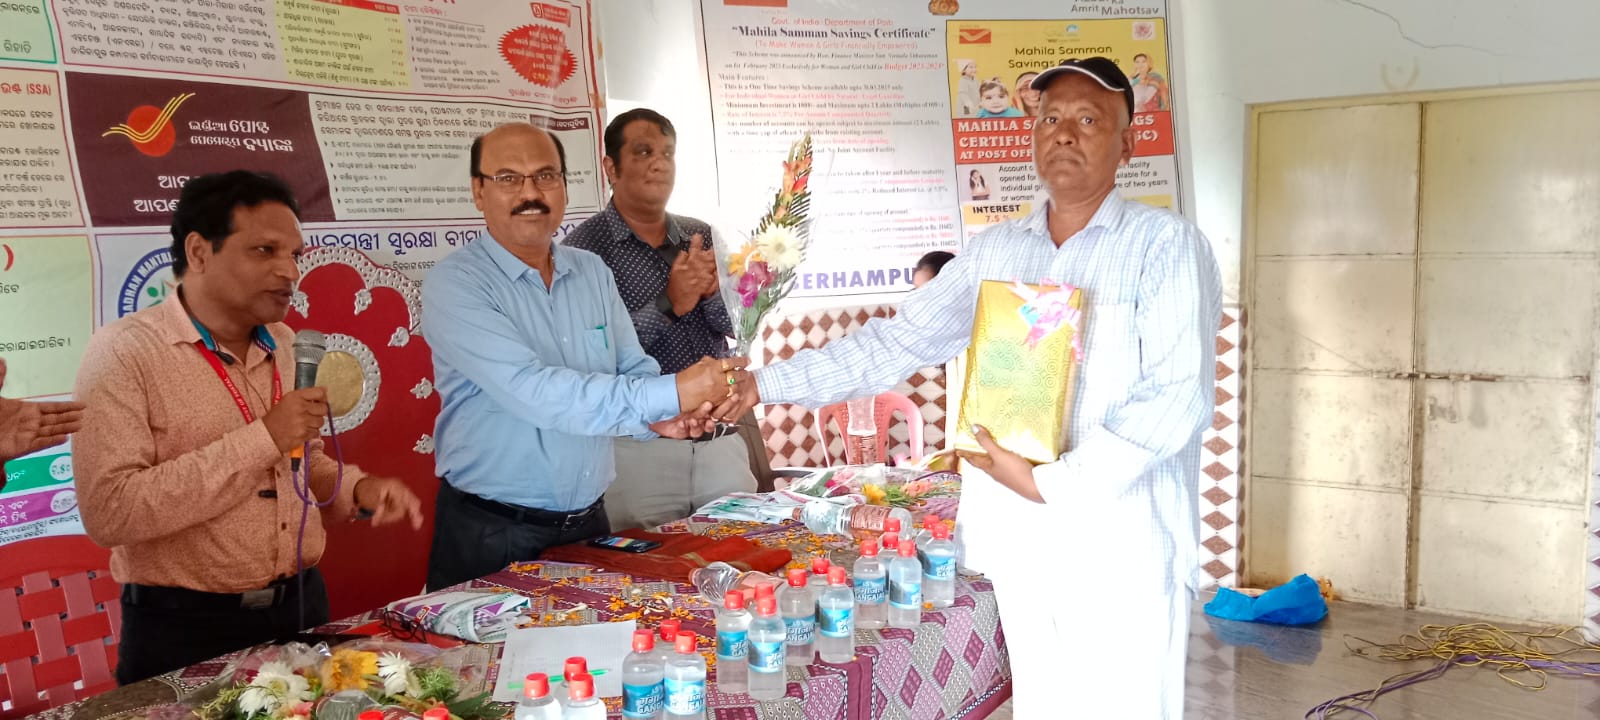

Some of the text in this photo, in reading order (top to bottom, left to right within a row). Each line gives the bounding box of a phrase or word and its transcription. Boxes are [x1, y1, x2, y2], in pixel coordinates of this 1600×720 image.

[1071, 4, 1159, 16] Amrit Mahotsav
[780, 27, 829, 38] Samman
[830, 28, 872, 39] Savings
[1015, 45, 1113, 56] Mahila Samman
[1008, 60, 1055, 69] Savings
[958, 119, 1020, 133] MAHILA
[960, 150, 974, 161] AT
[978, 150, 1007, 160] POST
[999, 165, 1027, 173] Account
[1000, 173, 1037, 183] opened for
[1000, 184, 1033, 192] individual
[973, 204, 1021, 213] INTEREST
[387, 231, 437, 254] ସୁରକ୍ଷା
